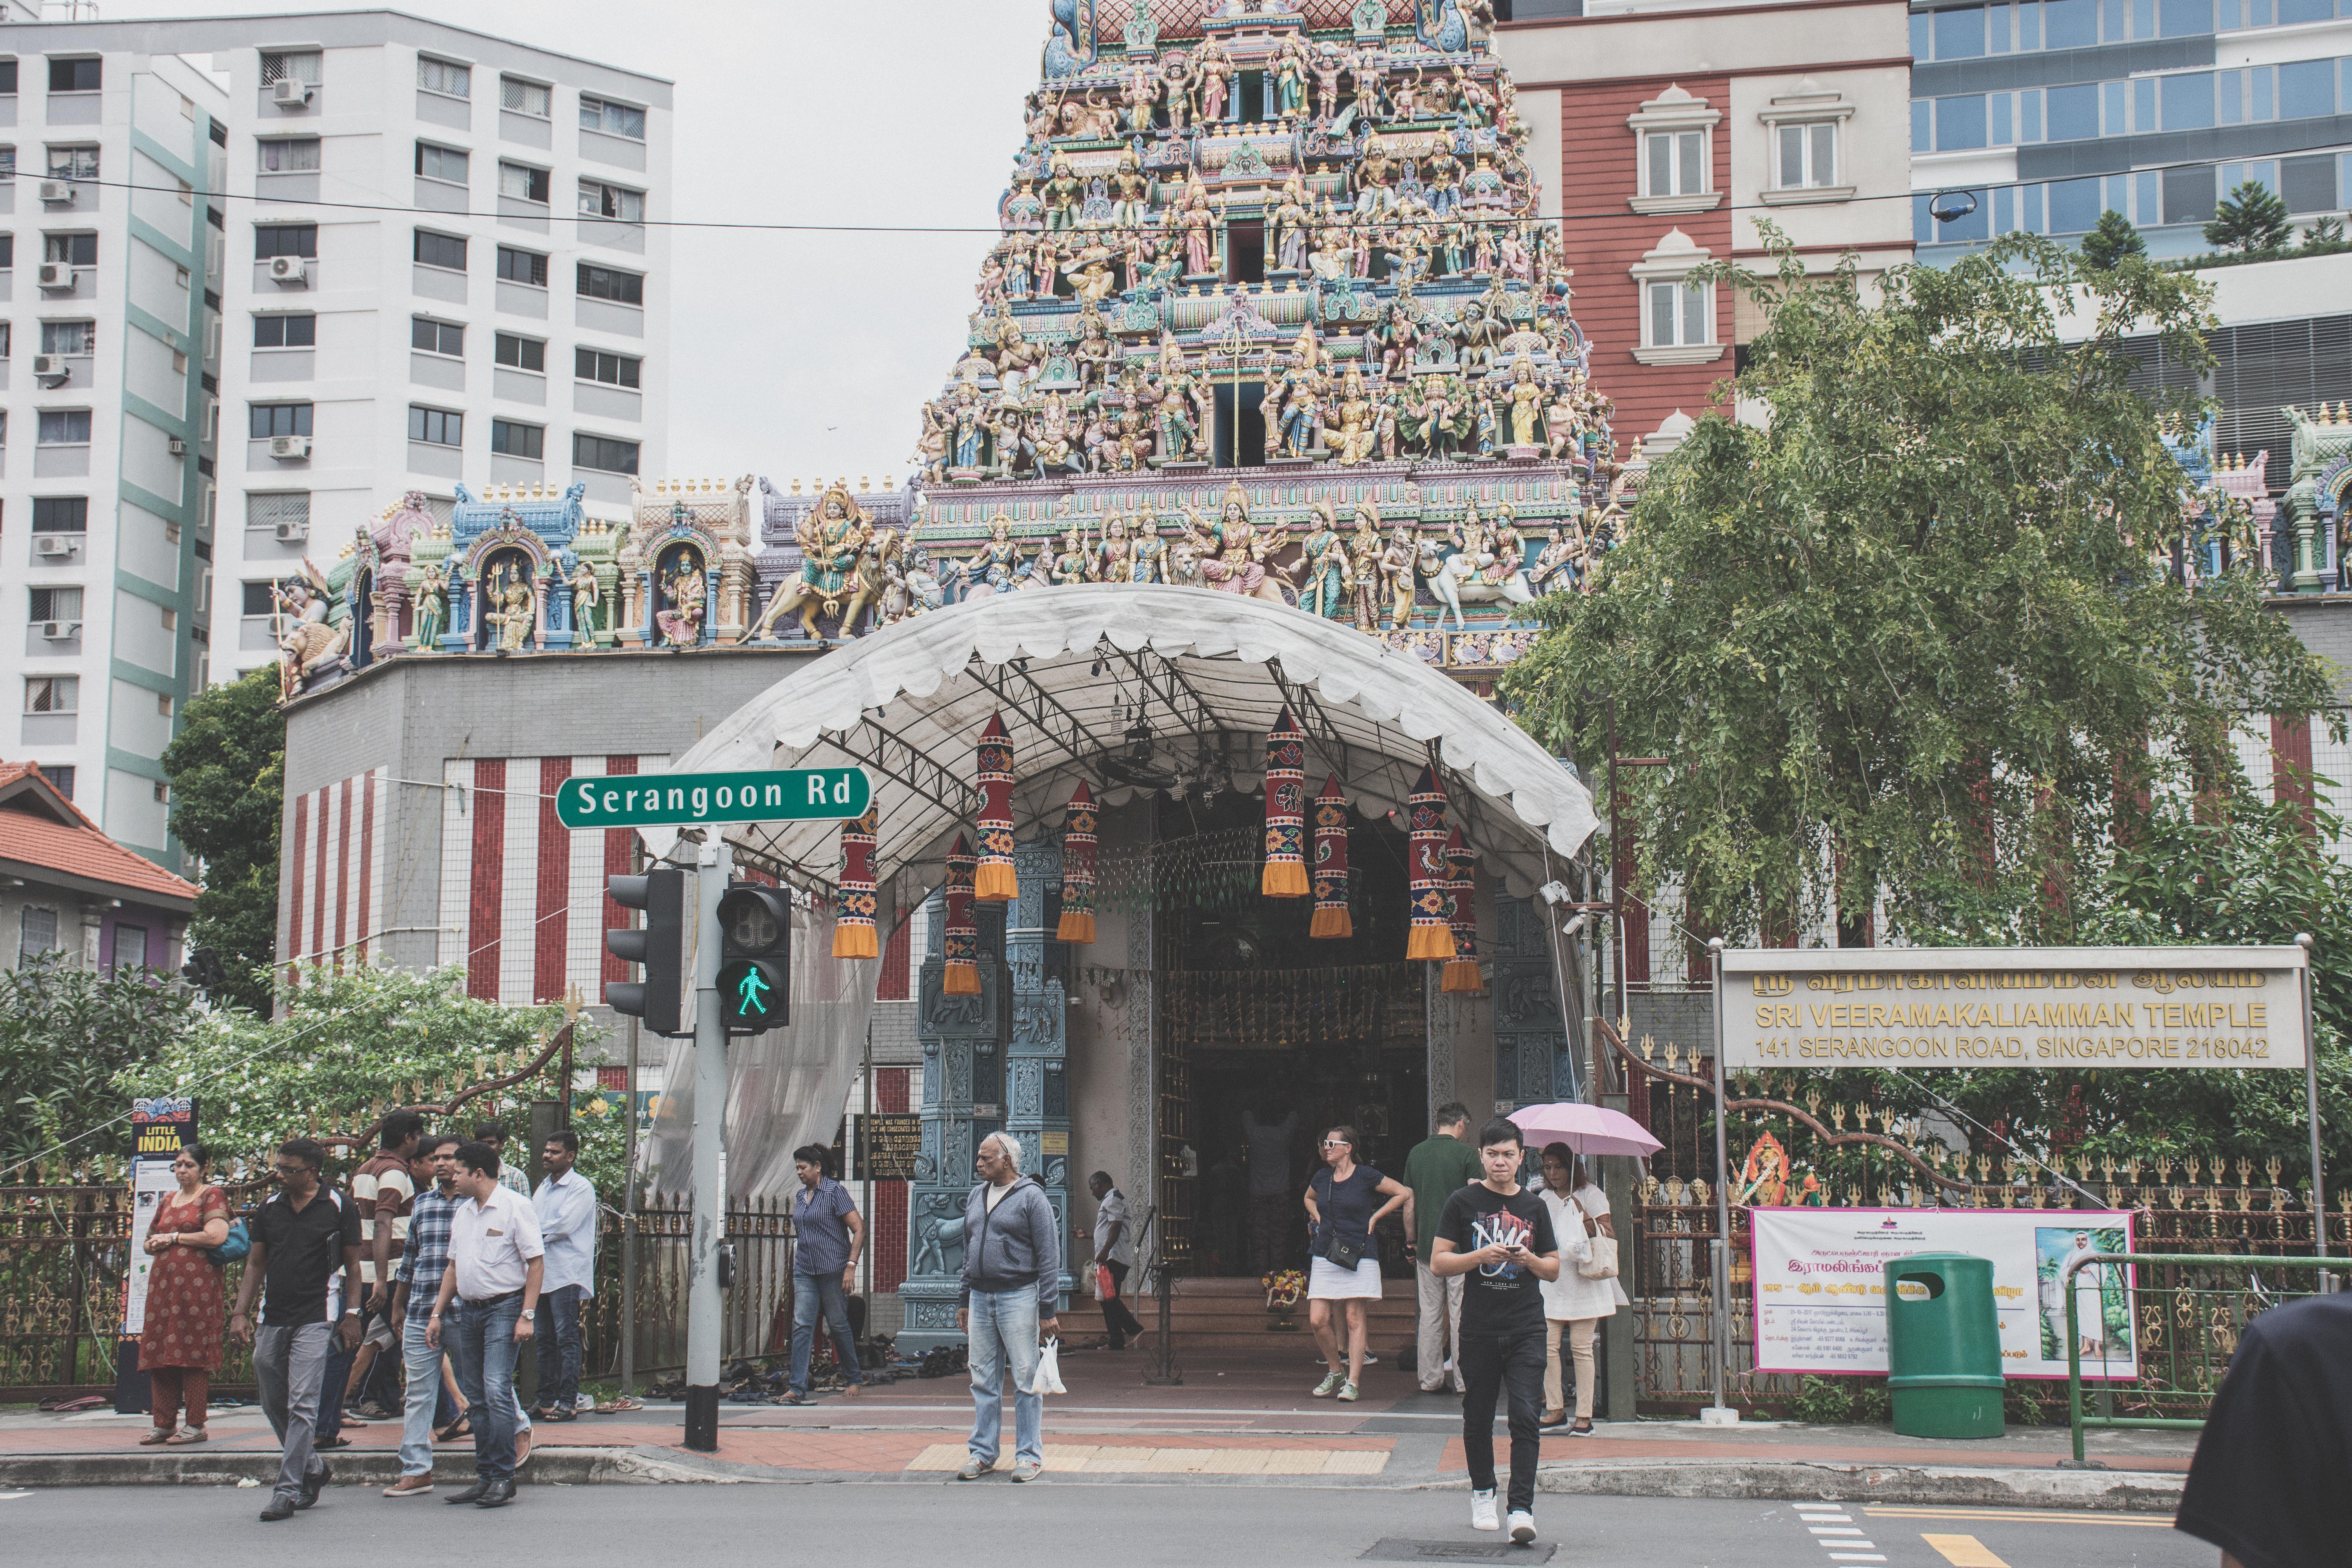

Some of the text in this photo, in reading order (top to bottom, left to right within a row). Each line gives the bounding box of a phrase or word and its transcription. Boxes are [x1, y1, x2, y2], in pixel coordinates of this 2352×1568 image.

[578, 773, 850, 817] Serangoon Rd
[1757, 1003, 2267, 1027] SRI VEERAMAKALIAMMAN TEMPLE
[1756, 1037, 2269, 1061] 141 SERANGOON ROAD, SINGAPORE 218042
[146, 1126, 176, 1135] LITTLE
[138, 1136, 182, 1152] INDIA
[1763, 1283, 1782, 1292] 195
